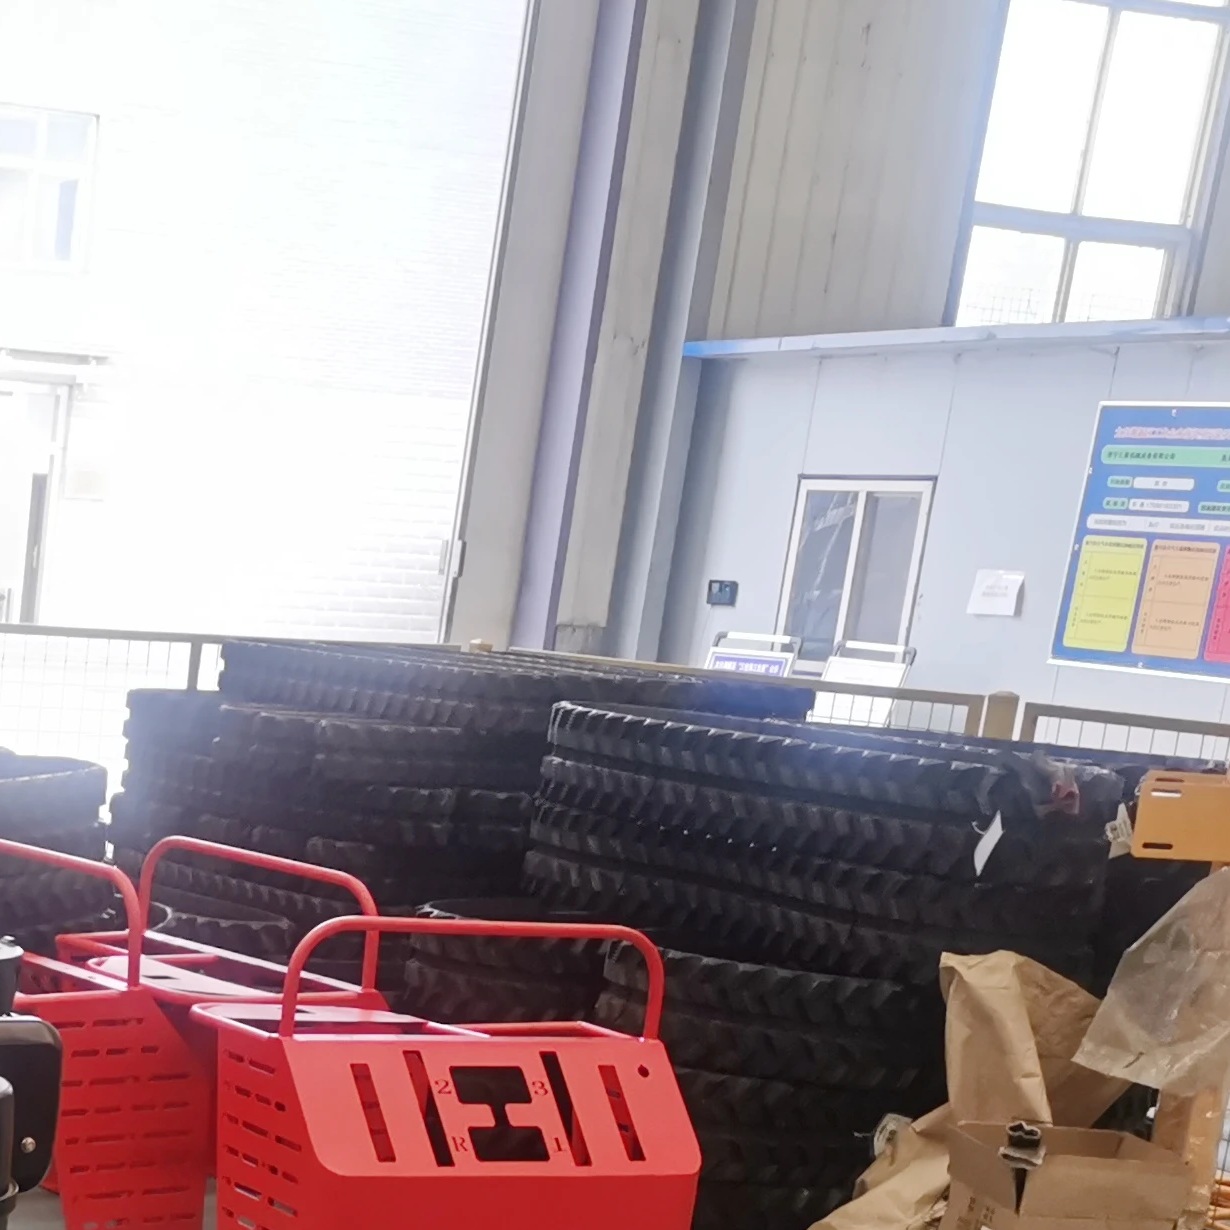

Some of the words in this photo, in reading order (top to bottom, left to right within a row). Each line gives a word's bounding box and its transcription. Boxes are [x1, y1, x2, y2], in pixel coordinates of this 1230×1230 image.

[435, 1079, 452, 1095] 2
[532, 1081, 548, 1096] 3
[452, 1136, 467, 1151] R
[554, 1137, 565, 1152] 1
